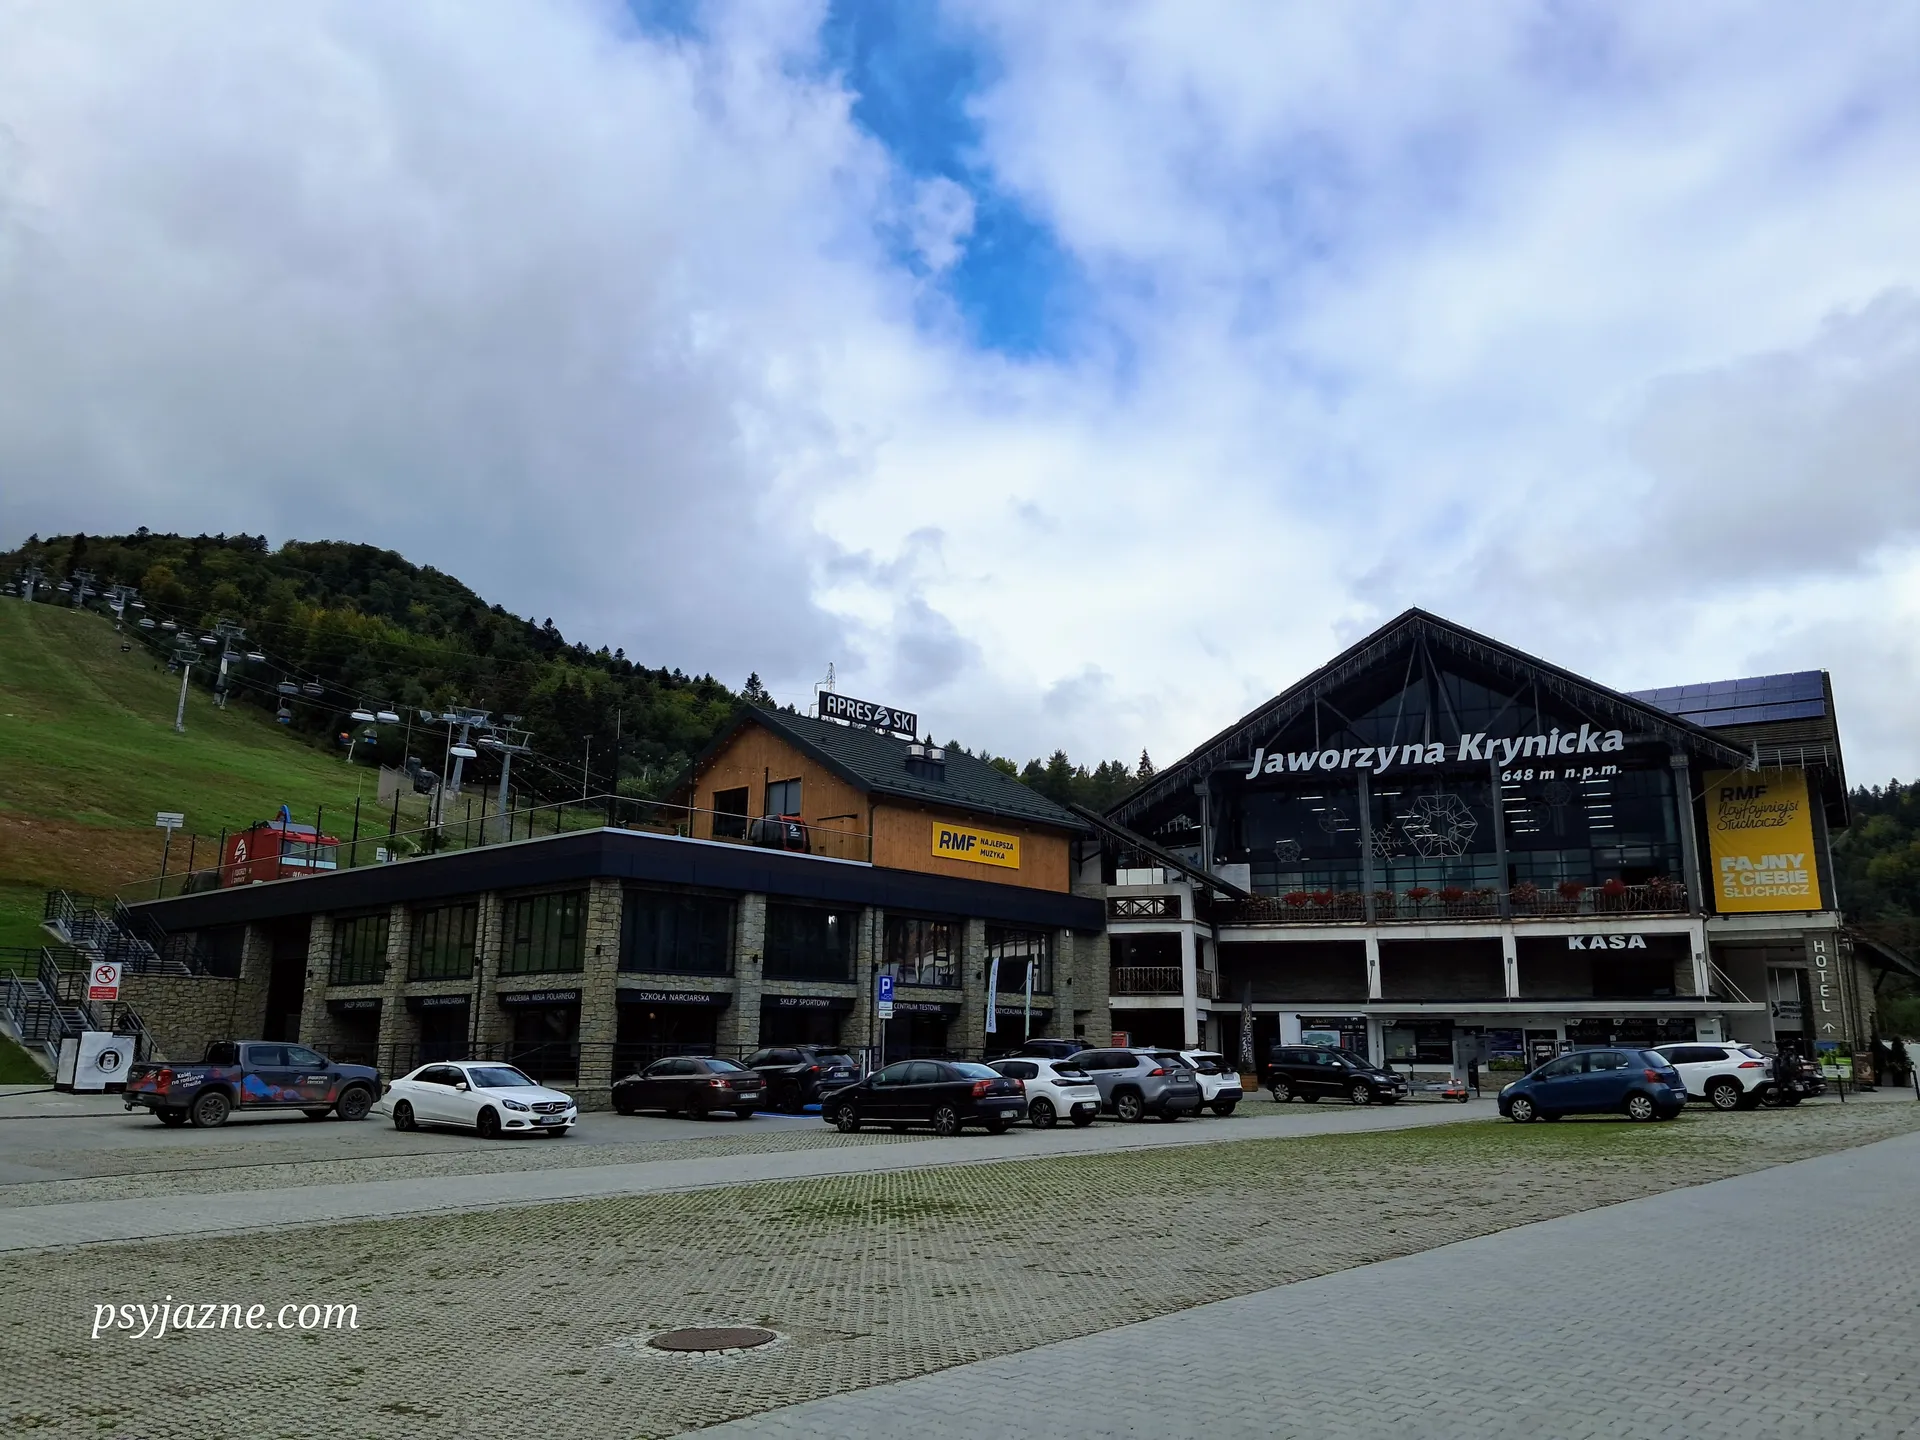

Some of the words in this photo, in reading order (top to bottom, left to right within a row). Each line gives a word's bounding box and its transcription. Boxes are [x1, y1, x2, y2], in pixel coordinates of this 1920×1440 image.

[826, 695, 872, 722] APRES
[893, 711, 914, 732] SKI
[1246, 741, 1446, 780] Jaworzyna
[1456, 724, 1625, 767] Krynicka
[1501, 769, 1534, 782] 648
[1539, 768, 1556, 780] m
[1565, 763, 1623, 781] n.p.m.
[1720, 785, 1768, 802] RMF
[939, 830, 977, 851] RMF
[980, 837, 1014, 850] NAJLEPSZA
[980, 848, 1005, 859] MUZYKA
[1721, 853, 1804, 872] FAJNY
[1723, 873, 1737, 886] Z
[1740, 870, 1809, 886] CIEBIE
[1724, 885, 1810, 898] SŁUCHACZ
[1568, 934, 1647, 950] KASA
[1813, 940, 1831, 1012] HOTEL
[881, 978, 891, 994] P
[439, 996, 466, 1005] NARCIARSKA
[506, 994, 530, 1002] AKADEMIA
[546, 991, 576, 1000] POLARNEGO
[640, 992, 667, 1001] SZKOŁA
[669, 993, 710, 1002] NARCIARSKA
[780, 998, 797, 1006] SKLEP
[799, 999, 830, 1007] SPORTOWY
[893, 1002, 918, 1010] CENTRUM
[919, 1003, 941, 1012] TESTOWE
